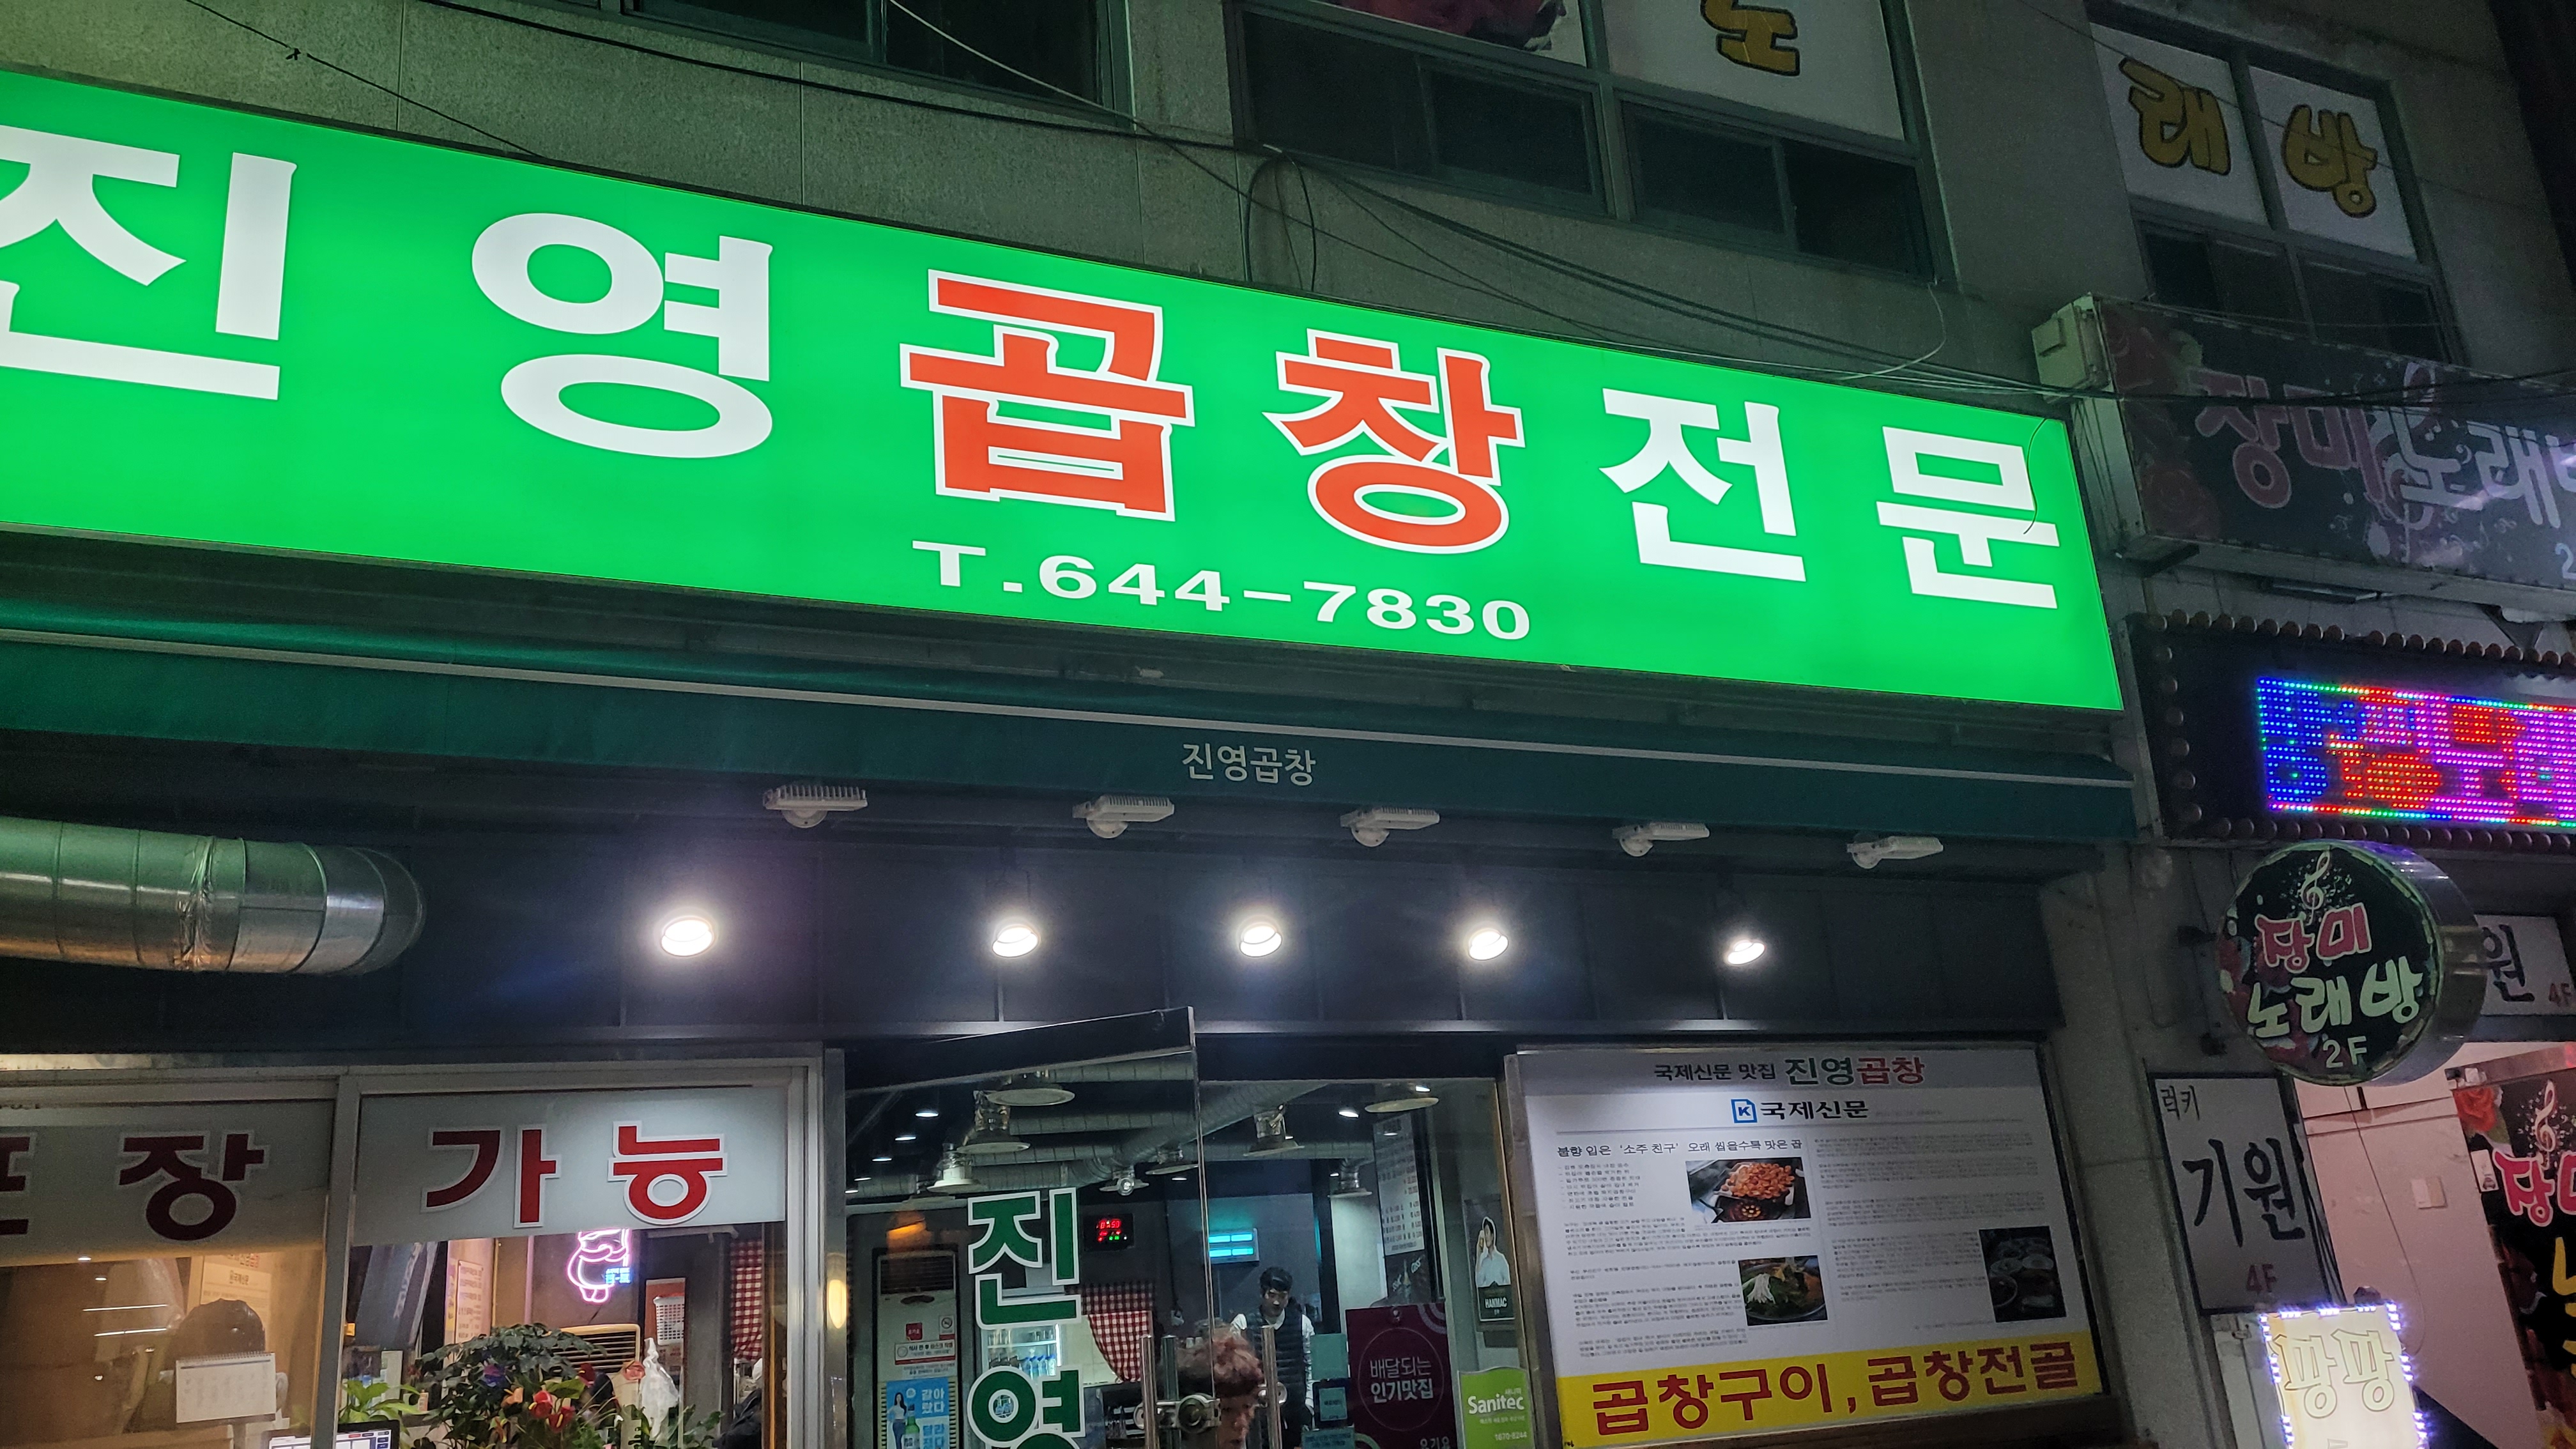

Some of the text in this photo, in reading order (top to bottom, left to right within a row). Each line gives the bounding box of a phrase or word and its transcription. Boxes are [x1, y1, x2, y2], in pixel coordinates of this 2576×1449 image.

[1182, 742, 1317, 786] 진영곱창
[2255, 903, 2372, 973] 장미
[2248, 956, 2423, 1038] 노래방
[2323, 1036, 2367, 1068] 2F
[1654, 1064, 1732, 1082] 국제신문
[1738, 1063, 1776, 1080] 맛집
[1759, 1100, 1869, 1120] 국제신문
[2161, 1085, 2200, 1121] 럭키
[1586, 1146, 1612, 1156] 입은
[1688, 1141, 1711, 1153] 오래
[1765, 1140, 1789, 1151] 맛은
[424, 1123, 726, 1225] 가능
[2182, 1137, 2306, 1248] 기원
[2246, 1264, 2278, 1294] 4F
[1370, 1356, 1432, 1378] 배달되는
[1867, 1341, 2079, 1407] 곱창전골
[2273, 1328, 2395, 1419] 팡팡
[1370, 1378, 1434, 1404] 인기맛집
[1468, 1393, 1525, 1414] Sanitec
